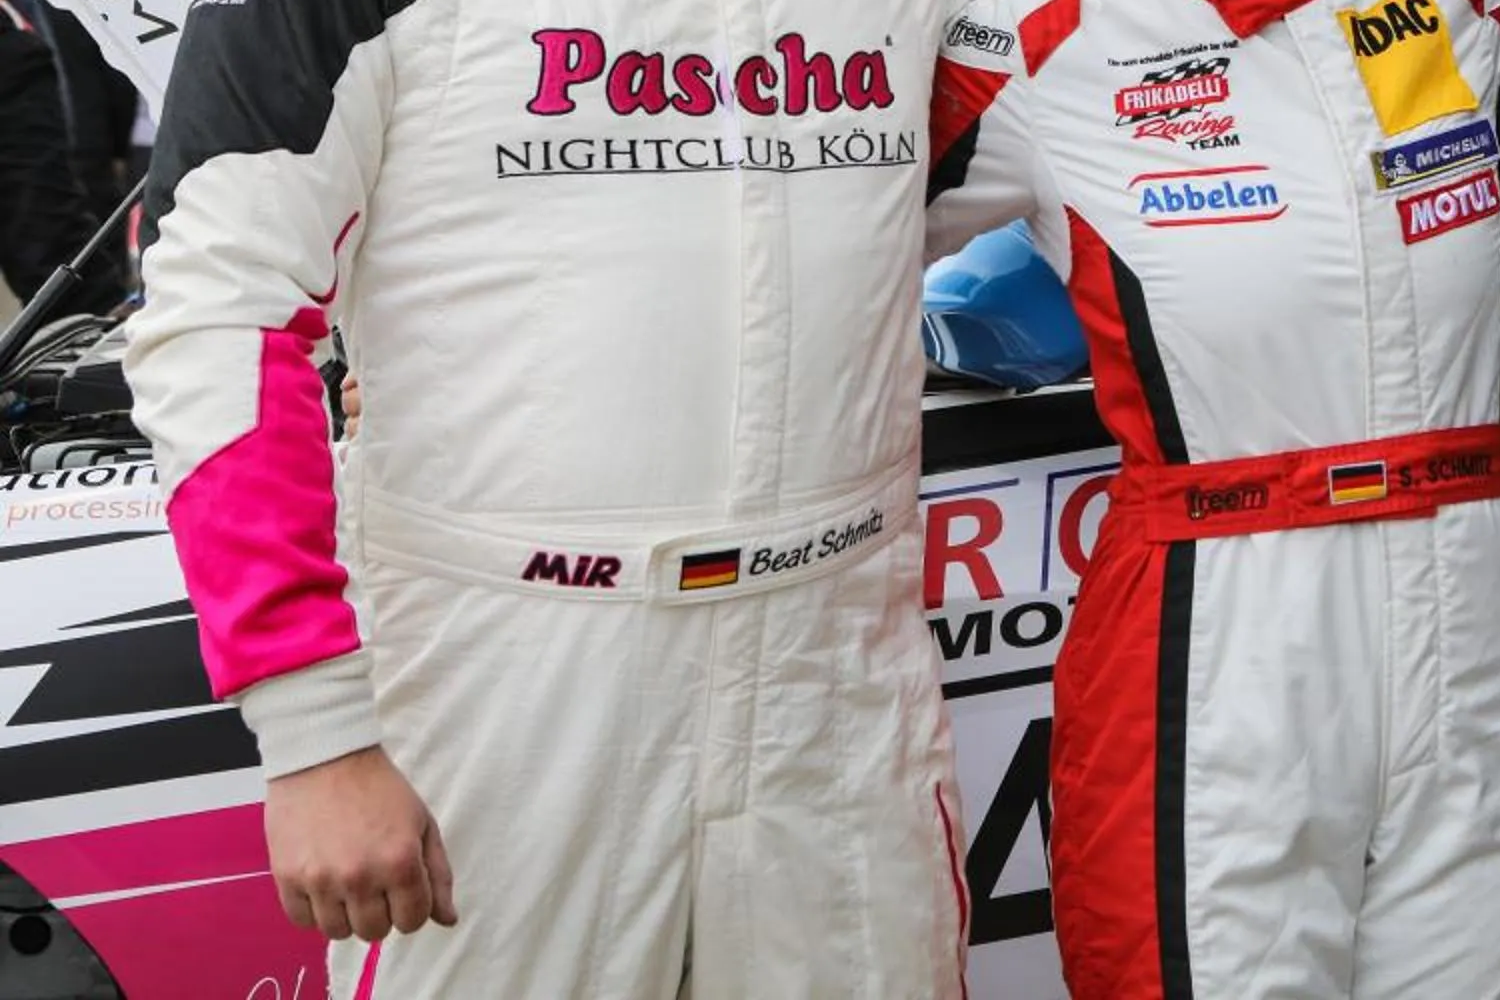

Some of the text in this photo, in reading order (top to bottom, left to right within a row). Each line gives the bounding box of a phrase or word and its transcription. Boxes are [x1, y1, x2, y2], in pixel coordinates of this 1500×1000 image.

[526, 28, 895, 116] Pascha
[1123, 77, 1221, 112] FRIKADELLI
[1132, 111, 1236, 142] Racing
[1186, 133, 1241, 152] TEAM
[497, 128, 917, 172] NIGHTCLUB KÖLN
[1140, 180, 1279, 214] Abbelen
[1411, 179, 1497, 235] MOTUL
[749, 506, 884, 576] Beat Schmitz
